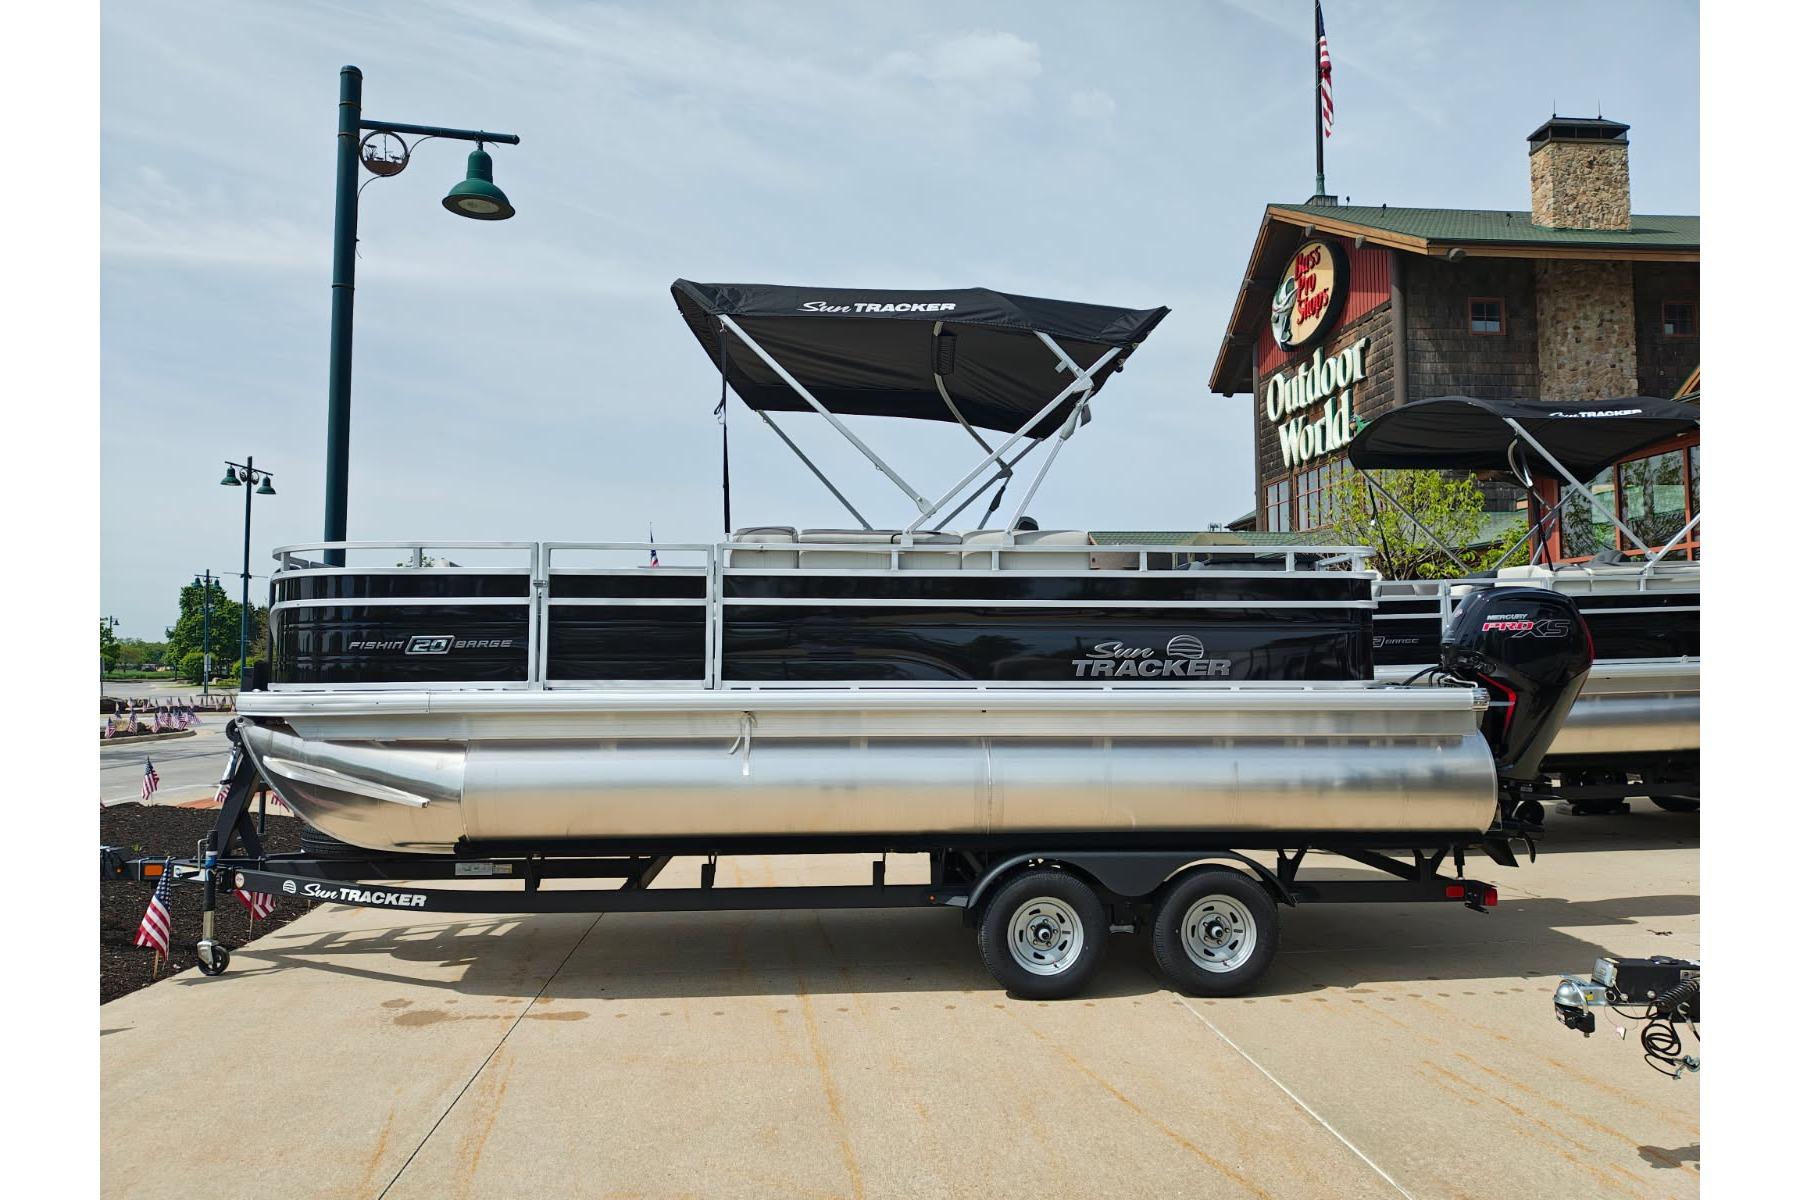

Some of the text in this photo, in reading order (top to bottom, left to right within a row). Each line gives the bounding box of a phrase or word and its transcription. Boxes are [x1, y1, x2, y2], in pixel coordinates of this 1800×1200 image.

[1294, 245, 1321, 281] Bass
[1297, 272, 1317, 303] Pro
[798, 301, 957, 313] Sun TRACKER
[1296, 288, 1330, 326] Shops
[1266, 337, 1368, 423] Outdoor
[1278, 388, 1353, 470] World
[1481, 621, 1535, 632] PRO
[412, 638, 448, 652] 20
[454, 639, 513, 649] BARGE
[1086, 641, 1155, 659] Sun
[1071, 659, 1232, 677] TRACKER
[300, 883, 427, 908] Sun TRACKER
